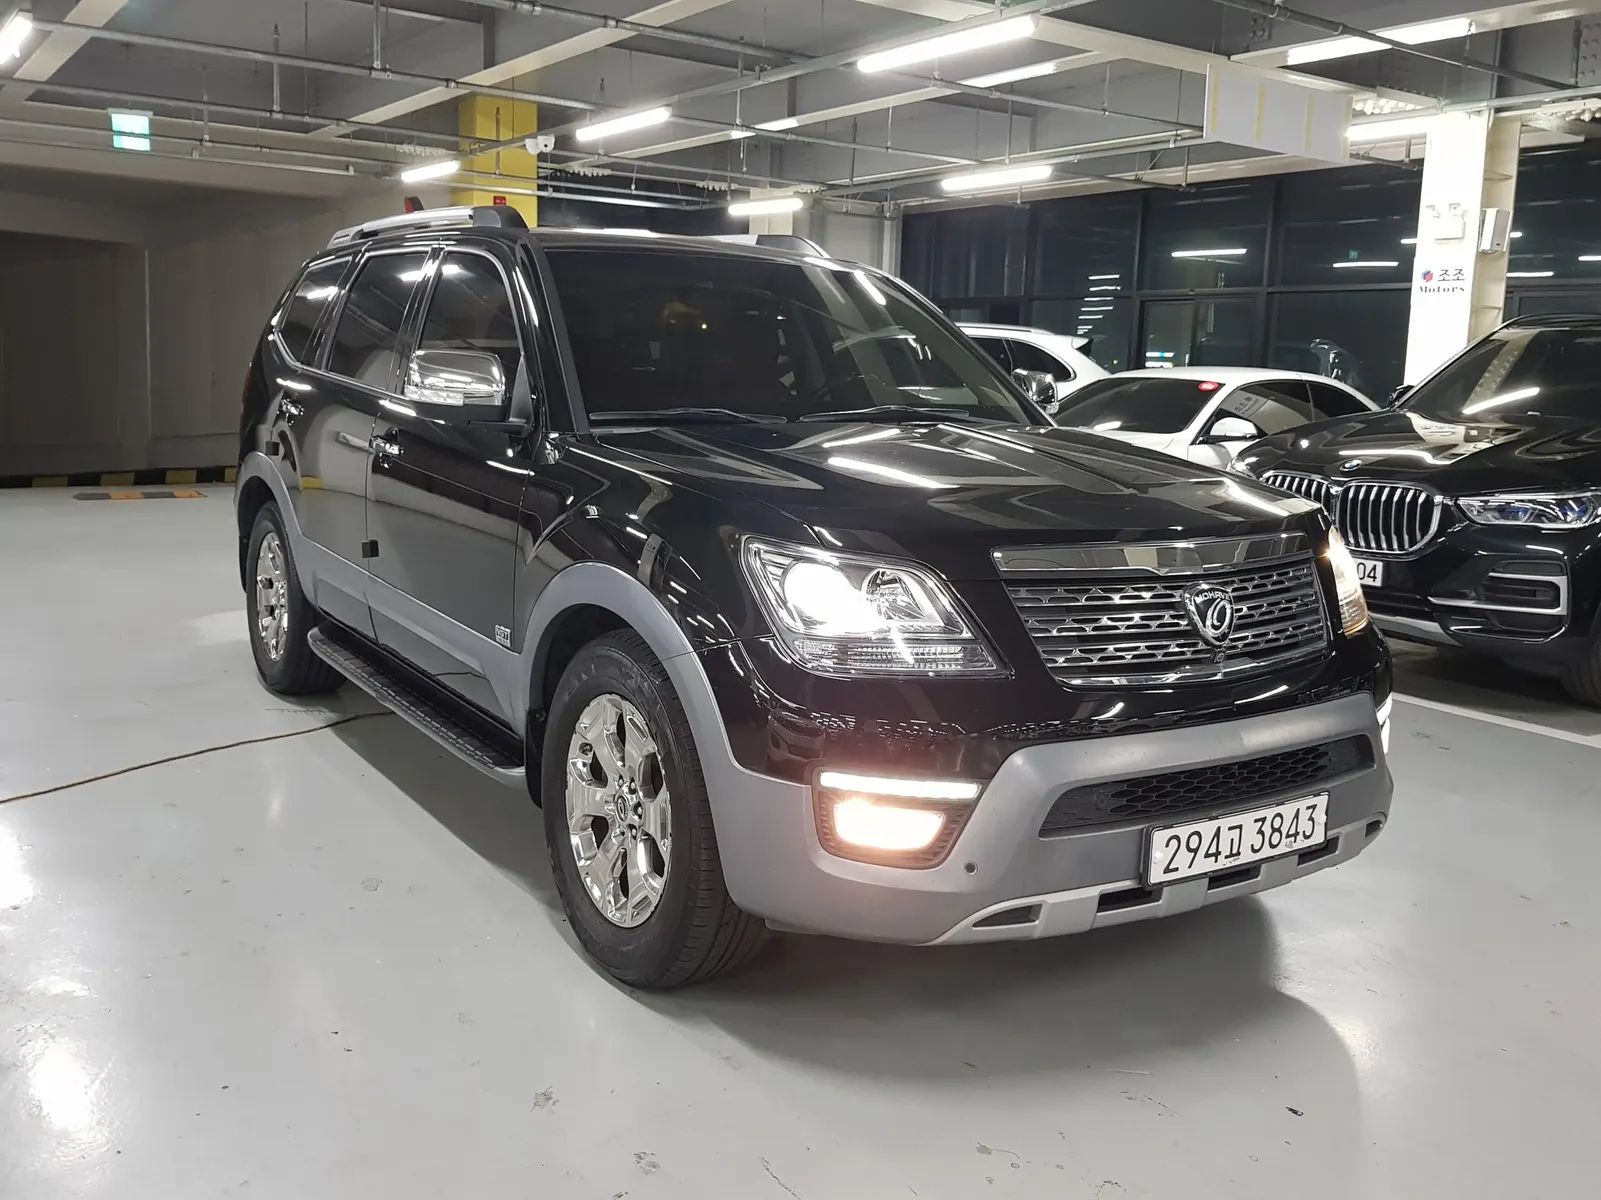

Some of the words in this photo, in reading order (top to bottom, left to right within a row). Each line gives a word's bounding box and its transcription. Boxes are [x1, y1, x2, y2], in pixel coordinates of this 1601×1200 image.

[1437, 268, 1465, 282] 조조
[1419, 285, 1465, 293] Motors
[1356, 562, 1378, 582] 04
[1250, 804, 1318, 854] 3843
